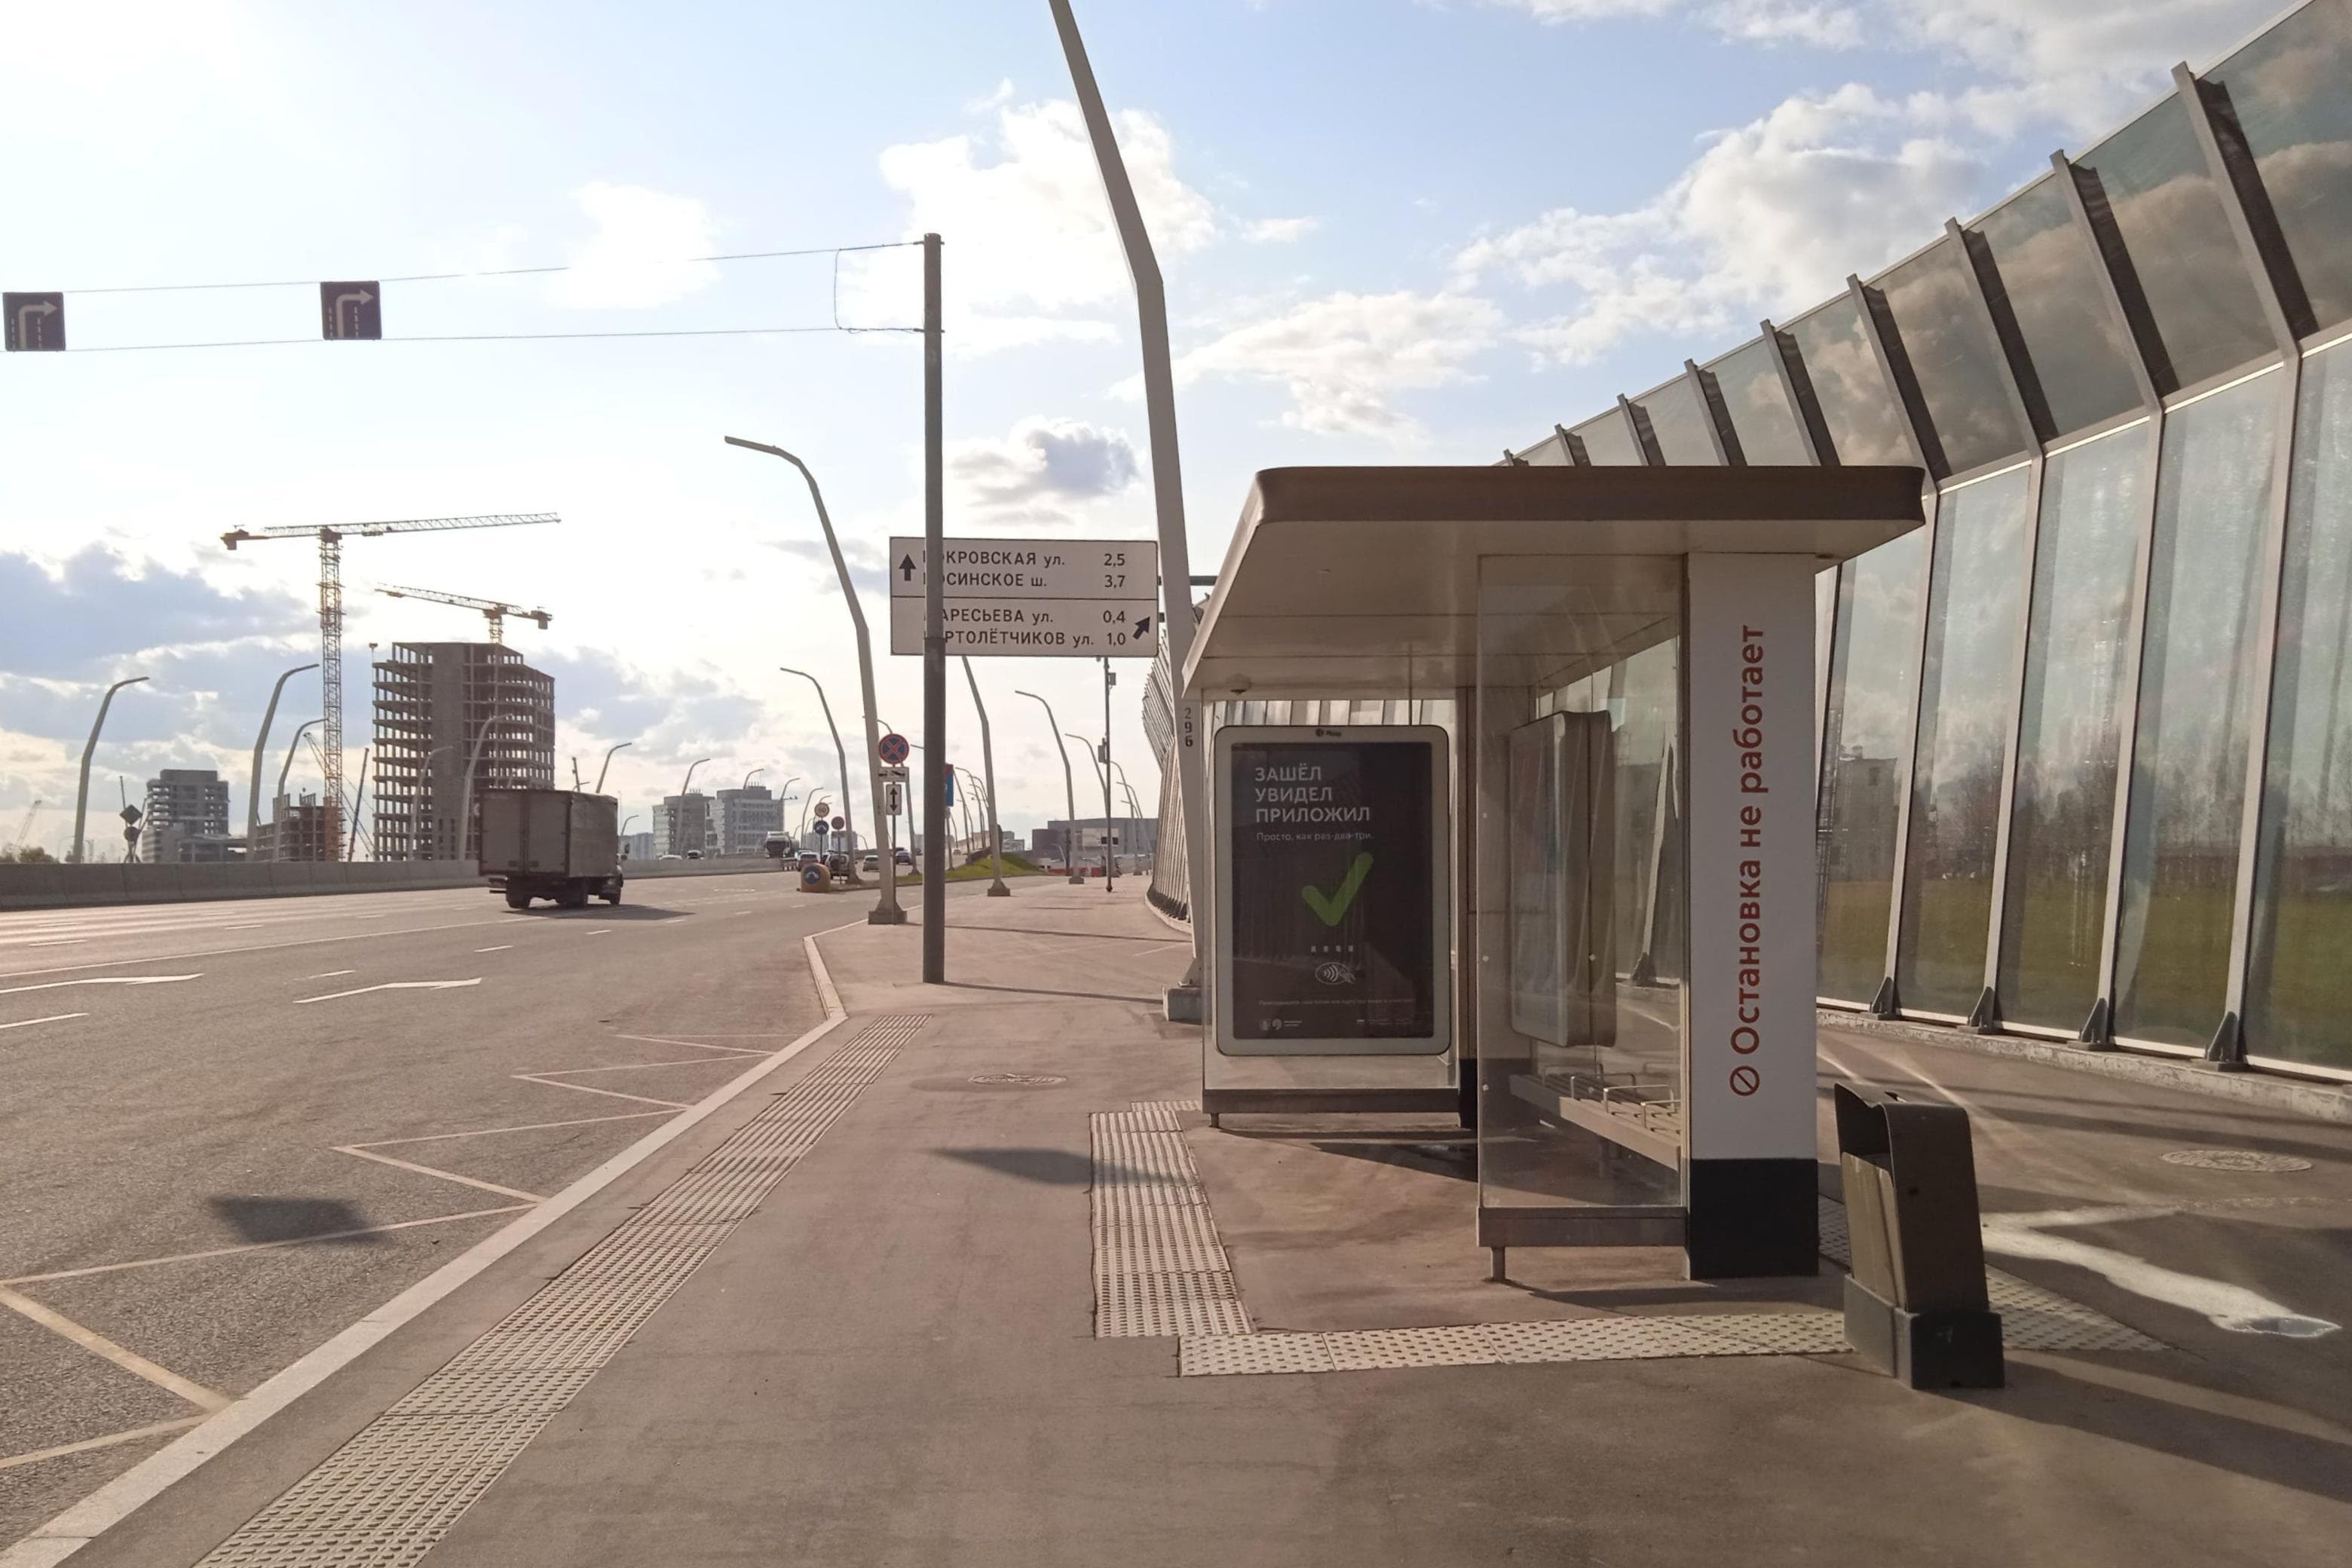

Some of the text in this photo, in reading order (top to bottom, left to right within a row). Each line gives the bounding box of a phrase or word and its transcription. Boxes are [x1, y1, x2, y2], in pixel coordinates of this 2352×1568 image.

[923, 550, 1125, 568] КРОВСКАЯ ул. 2,5
[923, 572, 1125, 589] СИНСКОЕ ш. 3,7
[923, 608, 1125, 626] АРЕСЬЕВА ул. 0,4
[923, 628, 1126, 648] РТОЛЁТЧИКОВ ул. 1,0
[1184, 707, 1193, 747] 296
[1255, 763, 1321, 781] ЗАШЁЛ
[1255, 787, 1333, 804] УВИДЕЛ
[1256, 807, 1370, 822] ПРИЛОЖИЛ
[1257, 832, 1294, 841] Просто,
[1730, 625, 1769, 1055] Остановка не работает
